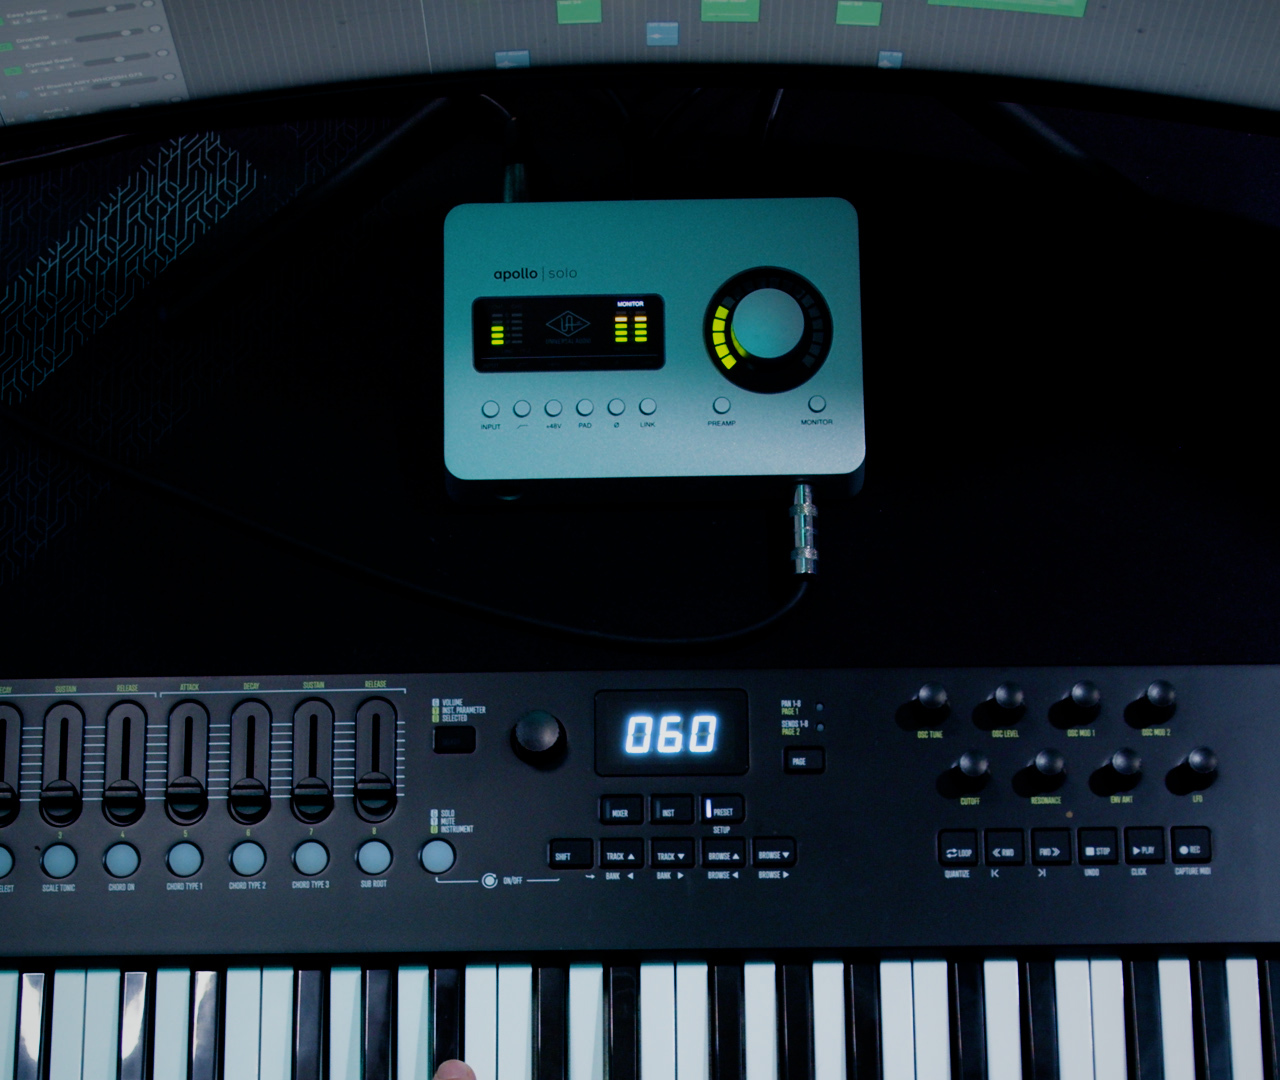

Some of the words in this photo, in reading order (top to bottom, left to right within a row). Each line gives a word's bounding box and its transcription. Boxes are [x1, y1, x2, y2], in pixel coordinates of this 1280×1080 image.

[493, 267, 538, 282] apollo
[548, 267, 577, 280] solo
[625, 716, 717, 754] 060
[960, 798, 980, 806] CUTOFF
[1031, 796, 1062, 804] RESONANCE
[1192, 795, 1203, 803] LFO
[958, 849, 972, 857] LOOP
[1096, 847, 1110, 856] STOP
[1141, 846, 1155, 855] PLAY
[1190, 846, 1200, 854] REC
[708, 852, 731, 860] BROWSE
[708, 871, 730, 879] BROWSE
[758, 871, 781, 879] BROWSE
[944, 870, 970, 878] QUANTIZE
[1084, 869, 1099, 877] UNDO
[1131, 868, 1147, 876] CLICK
[503, 877, 523, 885] ON/OFF
